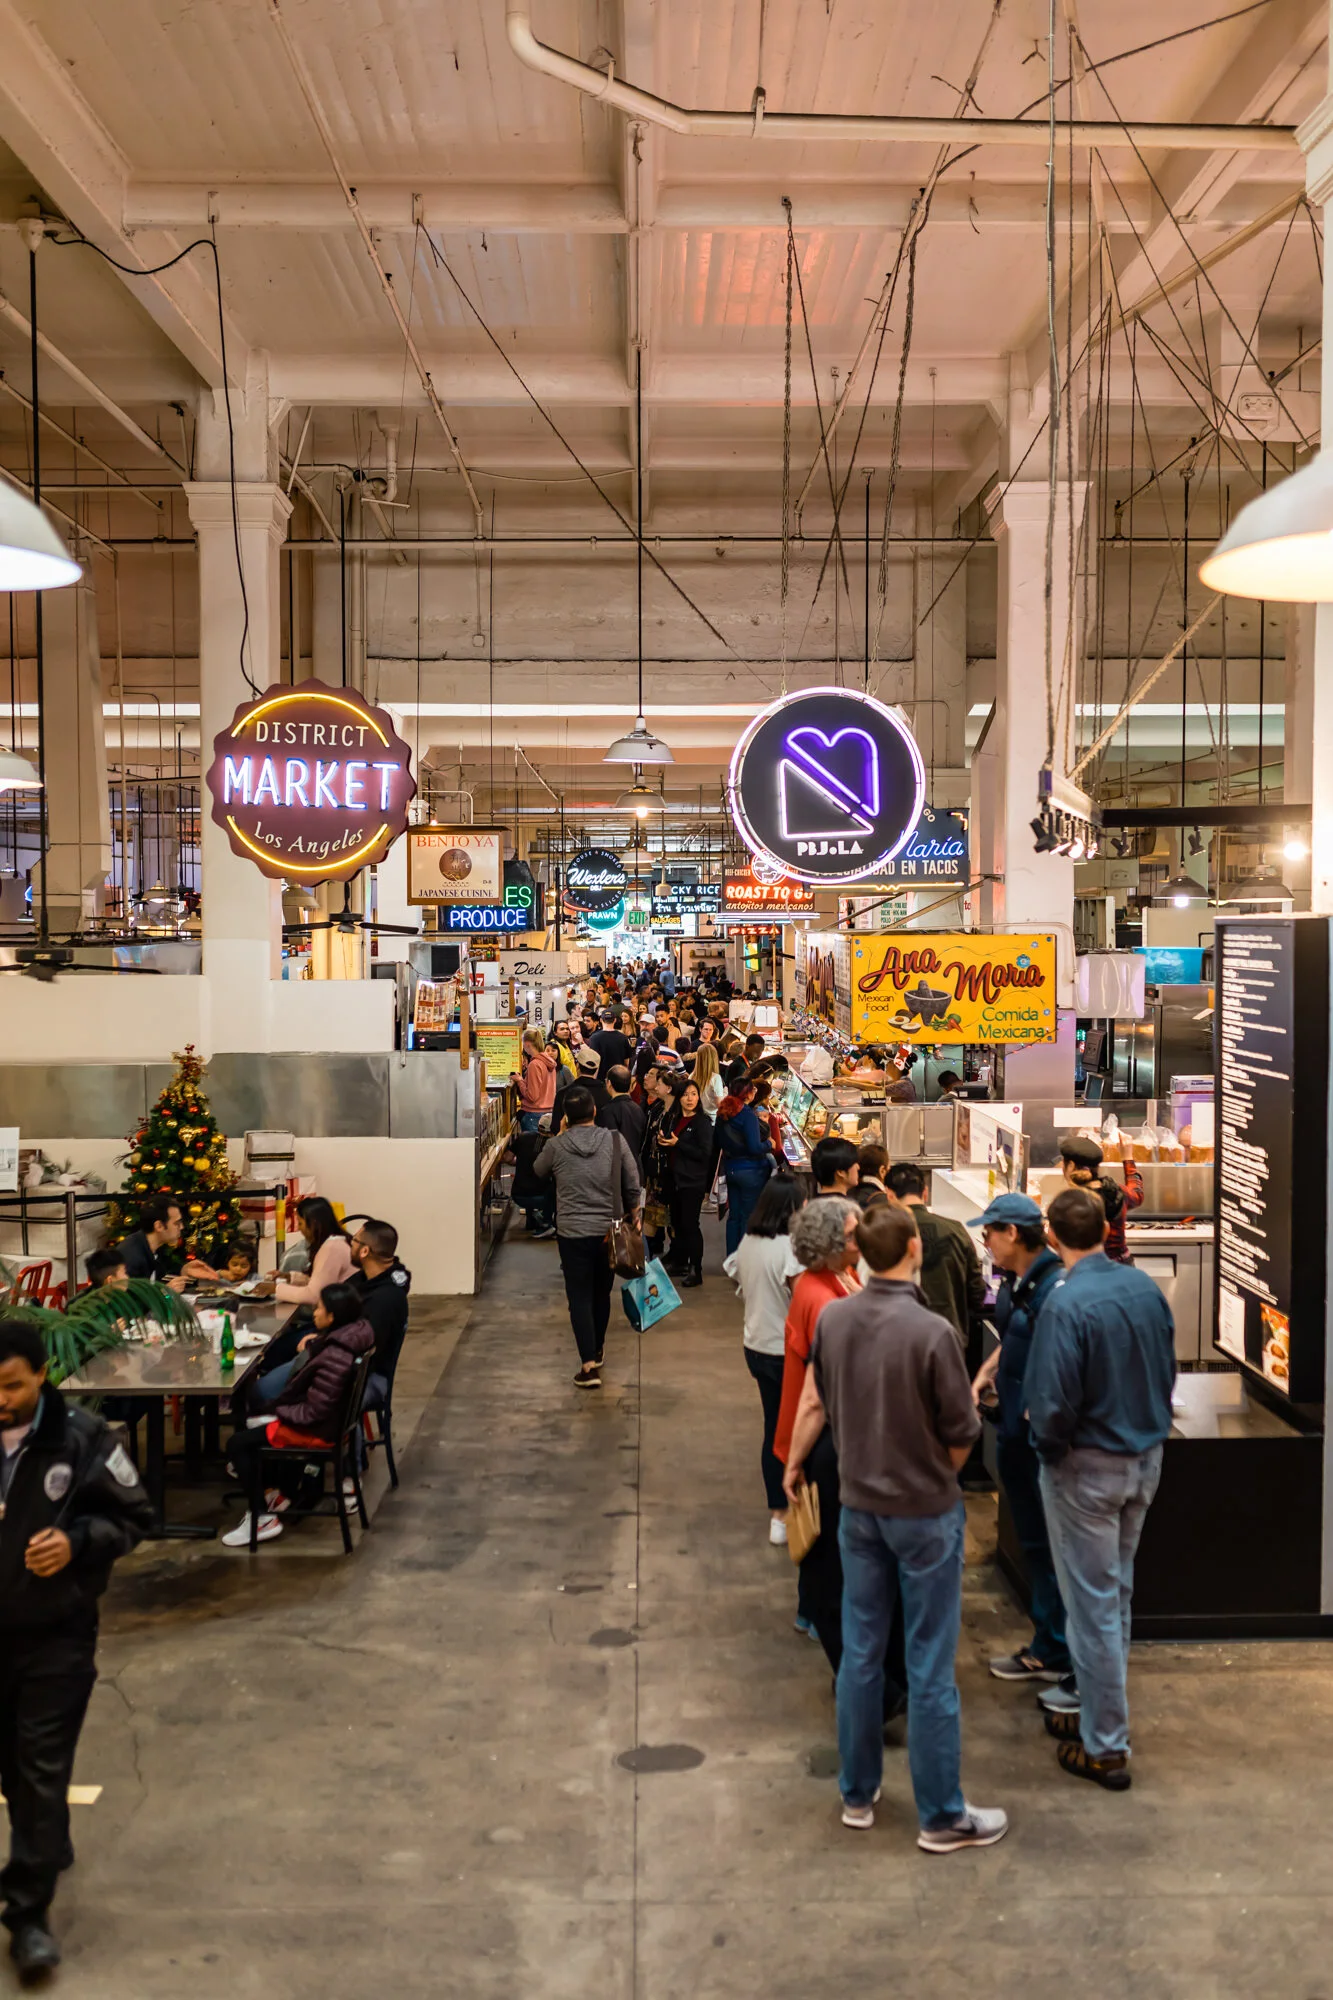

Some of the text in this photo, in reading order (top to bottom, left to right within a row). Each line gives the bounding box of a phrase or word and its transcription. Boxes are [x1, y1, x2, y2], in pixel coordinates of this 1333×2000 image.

[256, 720, 369, 747] DISTRICT
[223, 754, 401, 812] MARKET
[254, 821, 363, 860] Los Angeles
[417, 835, 495, 847] BENTO YA
[572, 850, 622, 869] HOUSE SMOKED
[901, 860, 916, 875] EN
[922, 859, 959, 875] TACOS
[418, 889, 494, 897] JAPANESE CUISINE
[696, 885, 720, 895] RICE
[726, 885, 770, 899] ROAST
[773, 885, 791, 899] TO
[725, 901, 814, 913] antojitos mexcanos
[450, 909, 526, 928] PRODUCE
[587, 911, 618, 920] PRAWN
[628, 911, 646, 925] EXIT
[729, 927, 781, 936] PIZZA
[514, 961, 547, 975] Deli
[858, 946, 942, 992] Ana
[943, 961, 1045, 1005] Maria
[857, 993, 895, 1003] Mexican
[866, 1003, 890, 1012] Food
[982, 1006, 1039, 1022] Comida
[978, 1024, 1046, 1039] Mexicana
